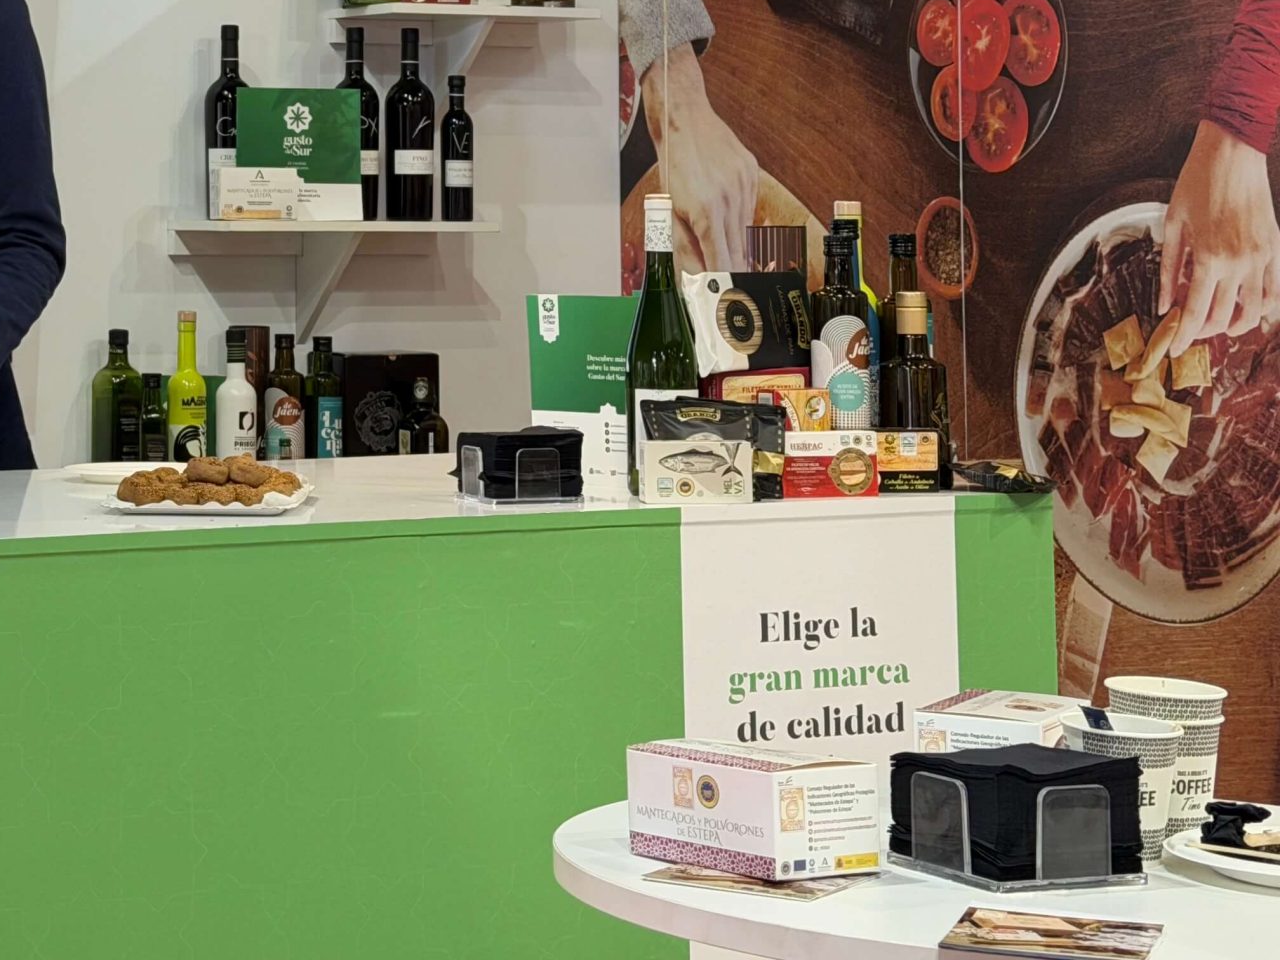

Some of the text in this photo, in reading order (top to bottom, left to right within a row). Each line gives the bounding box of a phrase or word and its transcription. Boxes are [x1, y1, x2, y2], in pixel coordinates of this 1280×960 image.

[283, 134, 313, 149] gusto
[292, 144, 313, 157] Sur
[790, 294, 810, 347] OBANDO
[586, 354, 614, 363] Descubre
[586, 363, 602, 371] sobre
[587, 372, 606, 380] Gusto
[606, 373, 615, 381] del
[790, 441, 823, 452] HERPAC
[723, 479, 733, 495] MEL
[734, 479, 743, 495] VA
[759, 606, 878, 651] Elige la
[728, 662, 910, 704] gran marca
[737, 701, 905, 743] de calidad
[1181, 797, 1201, 811] Time
[636, 805, 696, 826] MANTECADOS
[703, 817, 765, 839] POLVORONES
[676, 826, 723, 846] DE ESTEPA
